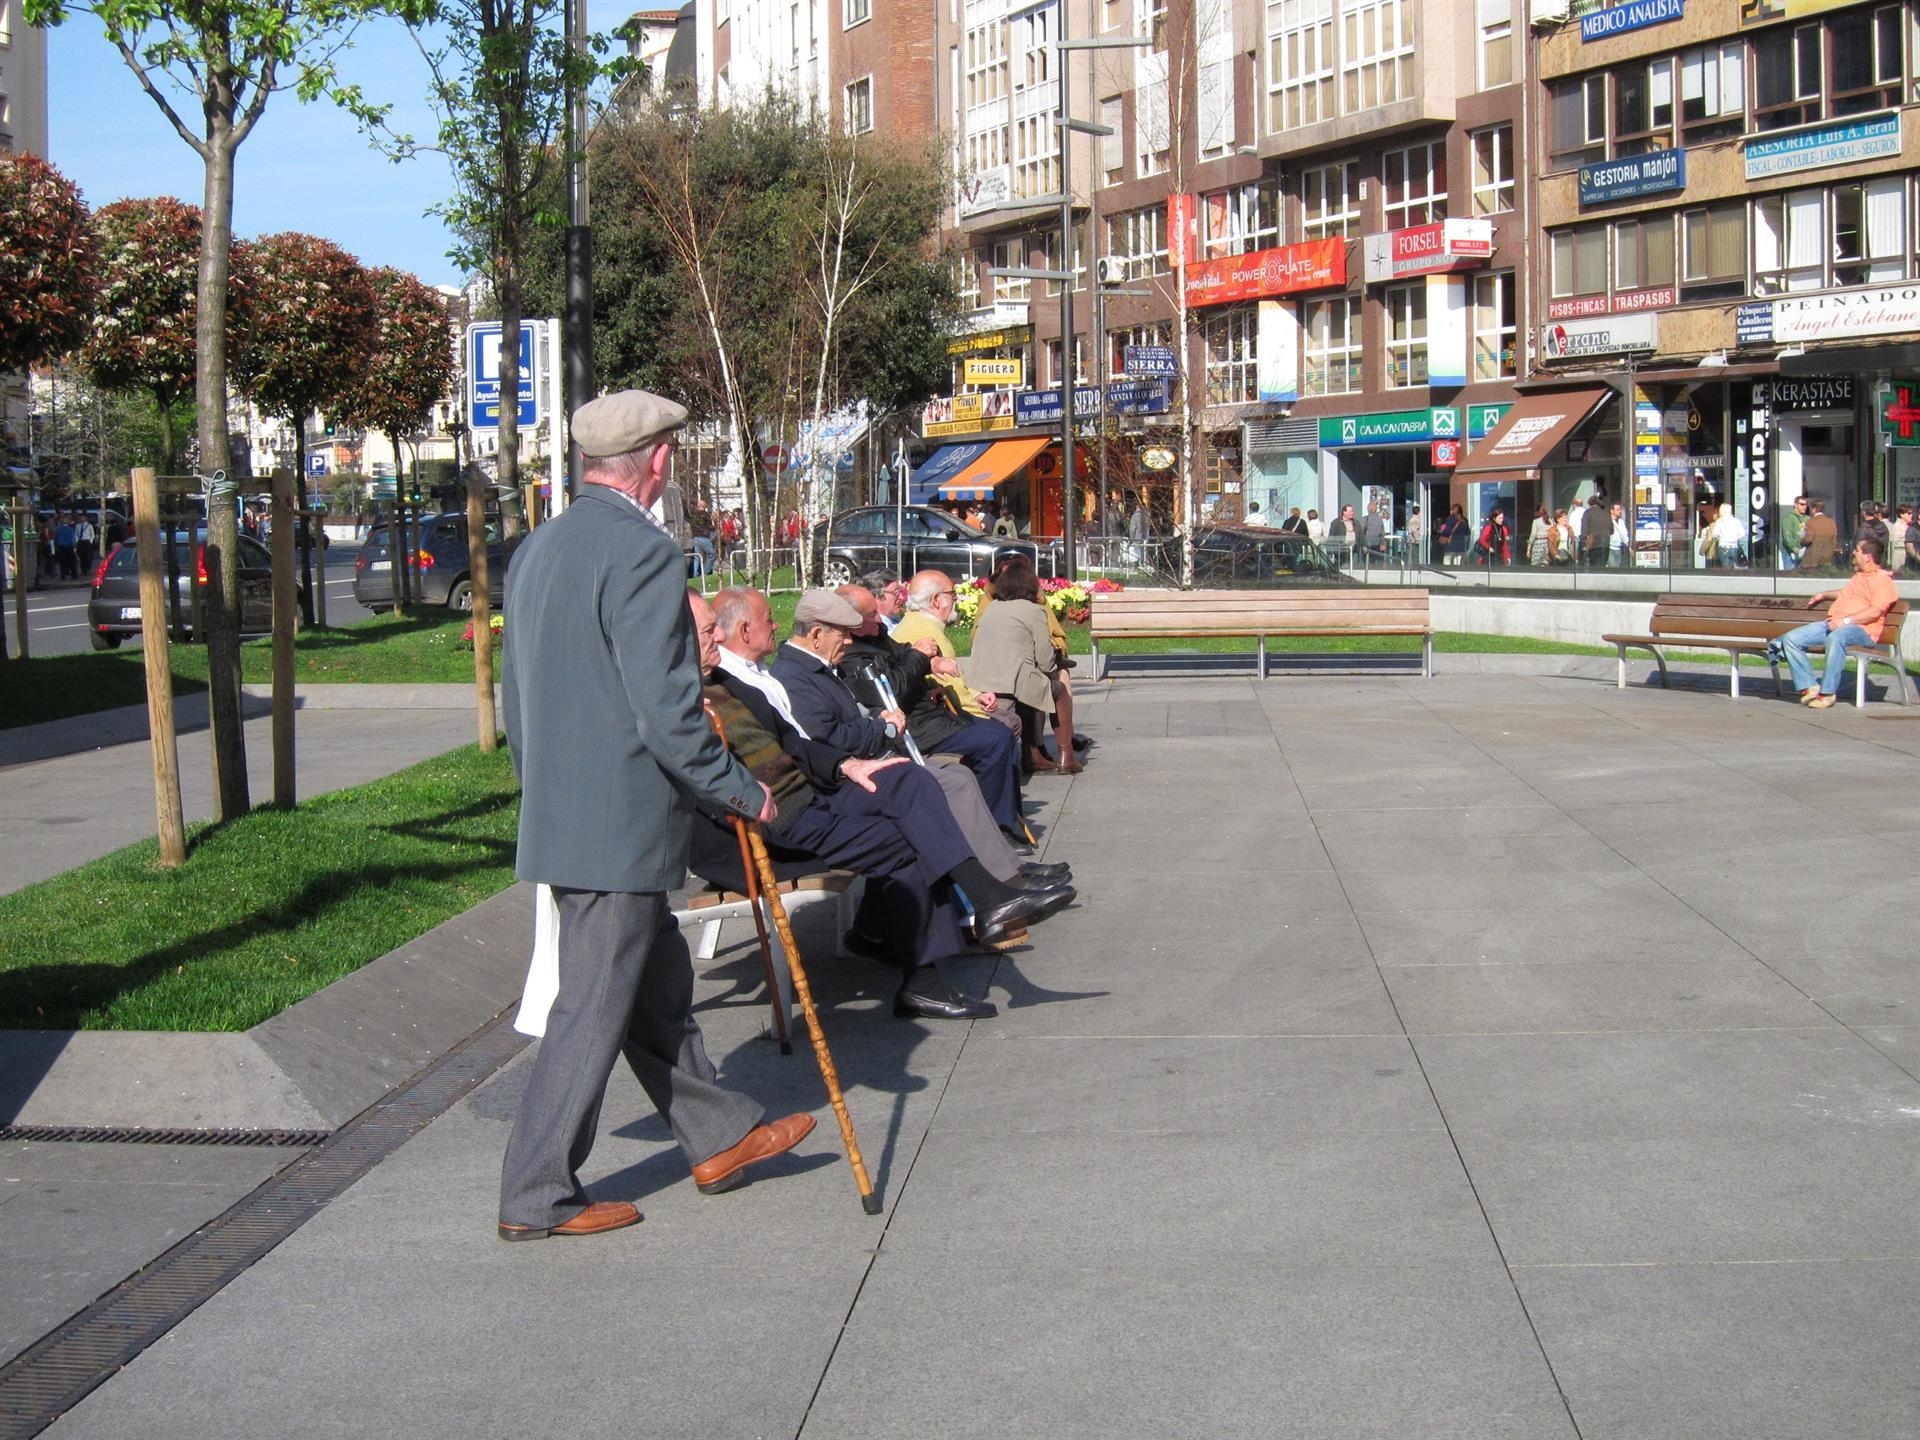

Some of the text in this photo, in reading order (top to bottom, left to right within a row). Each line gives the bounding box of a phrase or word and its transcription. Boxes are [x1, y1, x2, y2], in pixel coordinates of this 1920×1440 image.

[1583, 0, 1680, 37] MEDICO ANALISTA
[1818, 130, 1844, 144] Luis
[1748, 161, 1772, 175] FISCAL
[1820, 145, 1857, 163] LABORAL
[1862, 138, 1897, 156] SEGUROS
[1594, 152, 1677, 187] GESTORIA manjón
[1399, 231, 1438, 255] FORSEL
[1231, 259, 1312, 283] POWER PLATE
[1399, 257, 1432, 271] GRUPO
[1549, 299, 1605, 317] PISOS-FINCAS
[1614, 291, 1671, 310] TRASPASOS
[1596, 344, 1621, 353] PROPIEDAD
[1127, 360, 1175, 370] SIERRA
[476, 391, 532, 401] Ayuntnto
[1074, 390, 1101, 416] SIERR
[1793, 400, 1831, 408] PARIS
[1689, 414, 1697, 425] 4
[1360, 421, 1428, 436] CAJA CANTABRIA
[311, 456, 324, 470] P
[1752, 383, 1765, 544] WONDER
